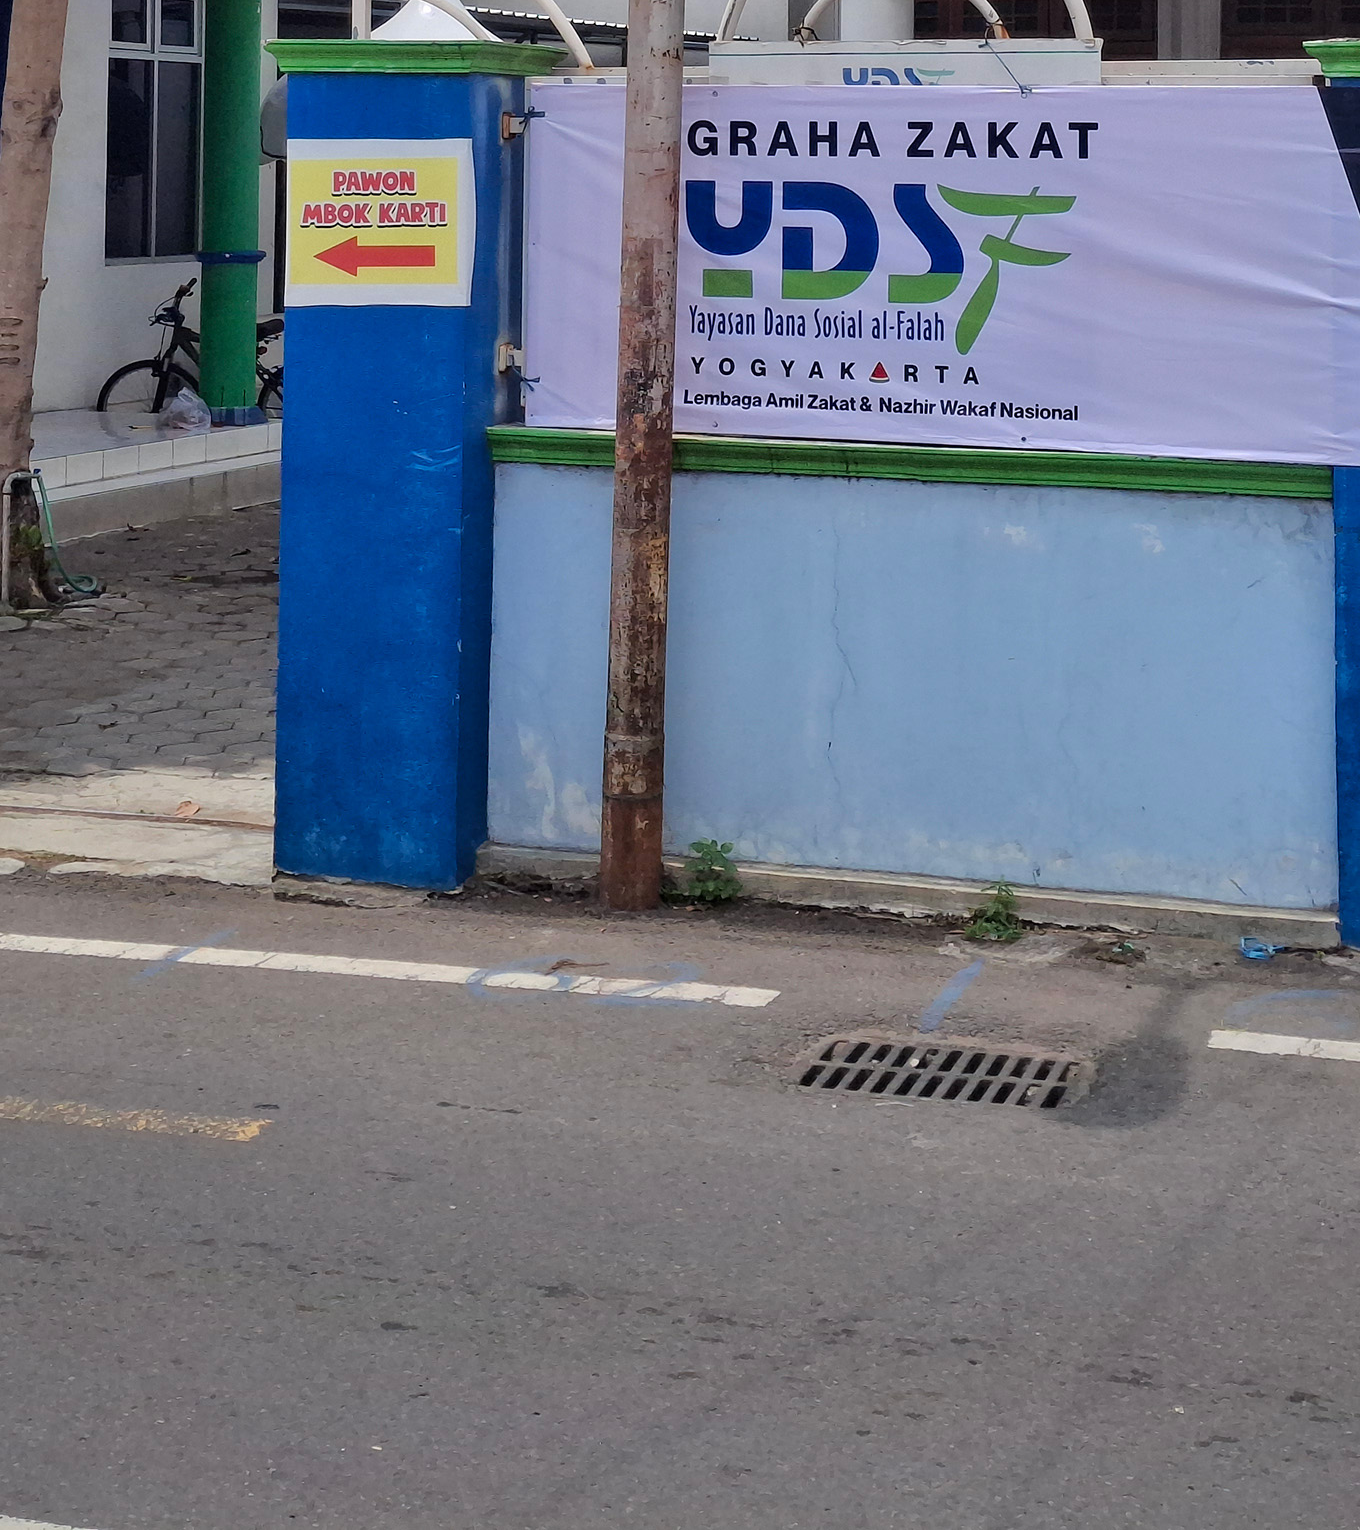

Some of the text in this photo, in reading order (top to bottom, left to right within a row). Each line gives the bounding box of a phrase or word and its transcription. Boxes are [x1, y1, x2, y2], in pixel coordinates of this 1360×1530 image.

[686, 120, 1099, 159] GRAHA ZAKAT
[332, 170, 417, 196] PAWON
[300, 201, 448, 228] MBOK KARTI
[685, 179, 1078, 356] YDSF
[688, 304, 946, 342] Yayasan Dana Sosial al-Falah
[682, 389, 1079, 421] Lembaga Amil Zakat & Nazhir Wakaf Nasional
